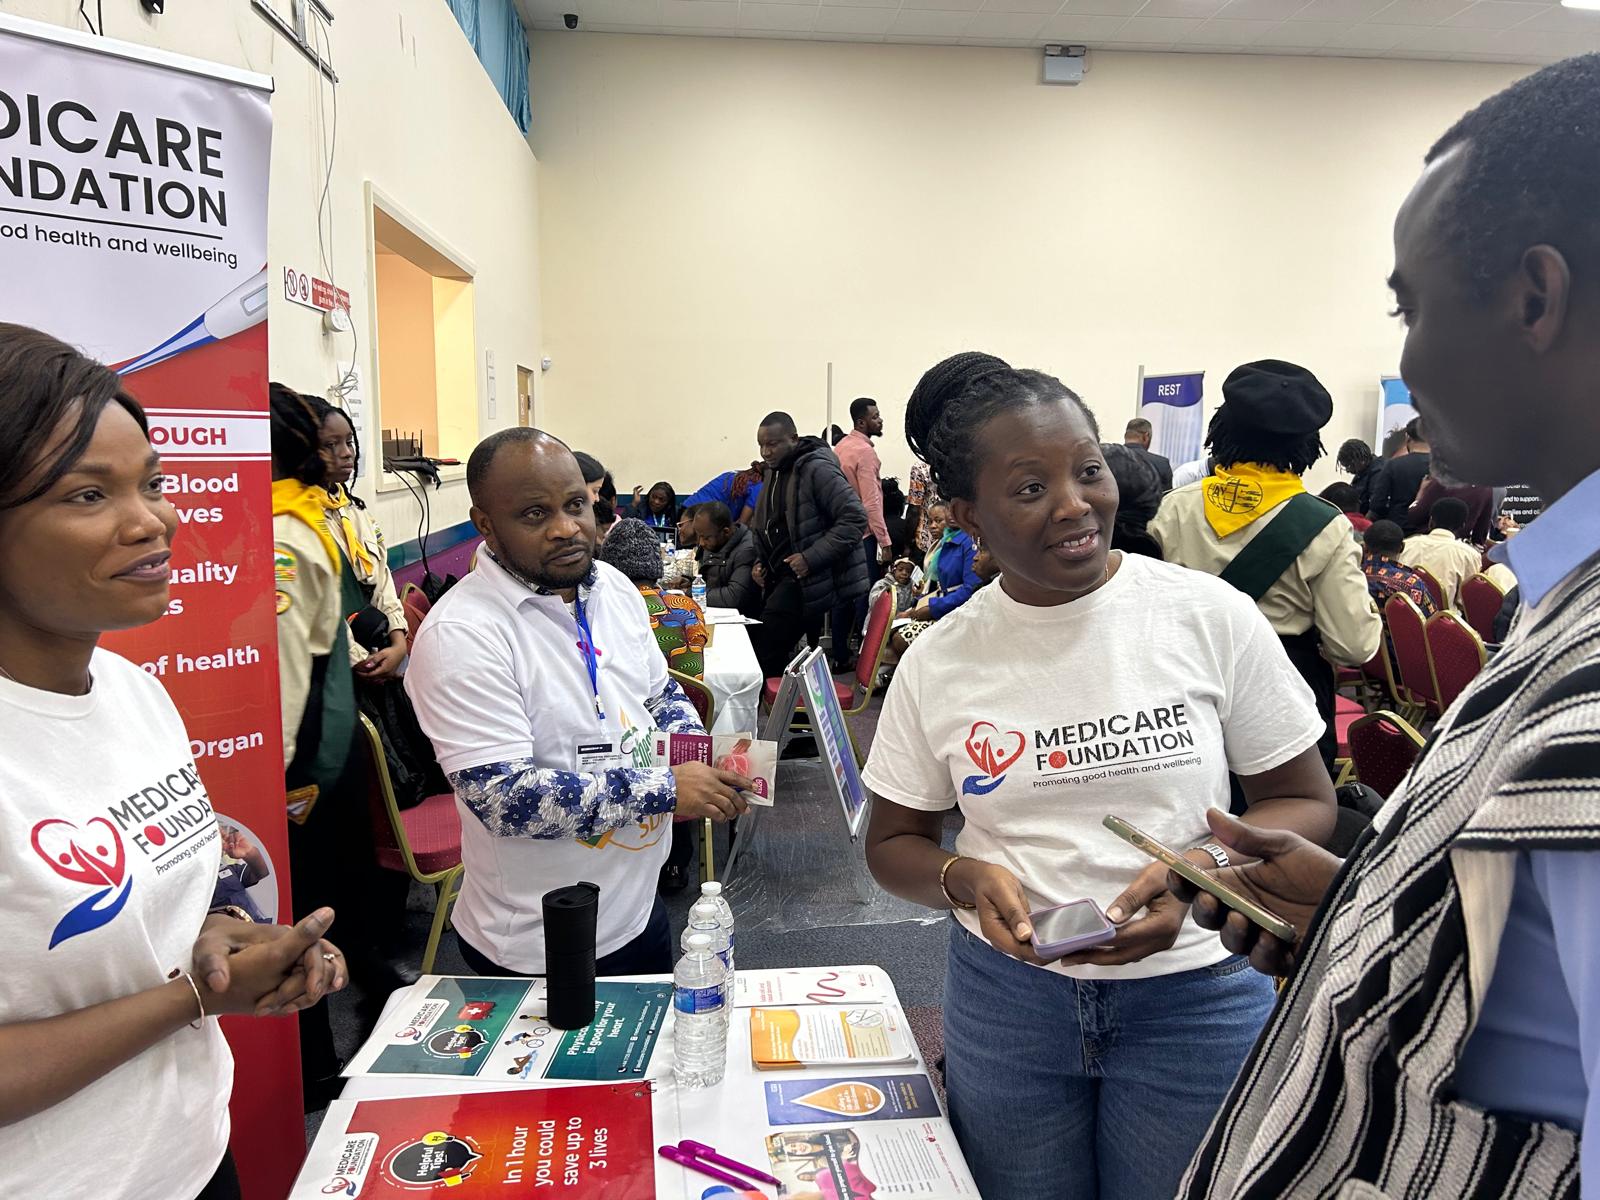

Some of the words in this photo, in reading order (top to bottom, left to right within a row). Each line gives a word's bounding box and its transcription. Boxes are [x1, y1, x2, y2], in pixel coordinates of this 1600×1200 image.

[35, 225, 101, 248] health
[108, 237, 148, 253] and
[153, 241, 238, 269] wellbeing
[1158, 384, 1181, 396] REST
[161, 473, 239, 494] Blood
[172, 503, 224, 523] ves
[140, 655, 168, 676] of
[176, 645, 260, 673] health
[1034, 703, 1188, 749] MEDICARE
[189, 731, 263, 759] Organ
[1036, 729, 1194, 771] FOUNDATION
[1033, 775, 1080, 788] Promoting
[1082, 771, 1107, 783] good
[1108, 767, 1139, 777] health
[1142, 762, 1161, 772] and
[1163, 756, 1202, 769] wellbeing
[132, 794, 214, 855] FOUNDA
[156, 848, 192, 875] Promoting
[589, 1024, 604, 1047] good
[599, 1017, 609, 1028] for
[604, 1002, 616, 1018] your
[607, 1017, 625, 1038] heart.
[567, 1025, 590, 1056] Physica
[537, 1120, 556, 1156] could
[566, 1116, 582, 1131] to
[506, 1126, 529, 1158] hour
[566, 1132, 585, 1151] up
[588, 1127, 608, 1157] lives
[336, 1140, 357, 1175] MEDICARE
[346, 1139, 366, 1175] FOUNDATION
[417, 1147, 434, 1176] Helpful
[430, 1150, 445, 1170] Tips!
[563, 1154, 580, 1186] save
[589, 1160, 607, 1169] 3
[502, 1169, 523, 1184] In
[535, 1159, 554, 1187] you
